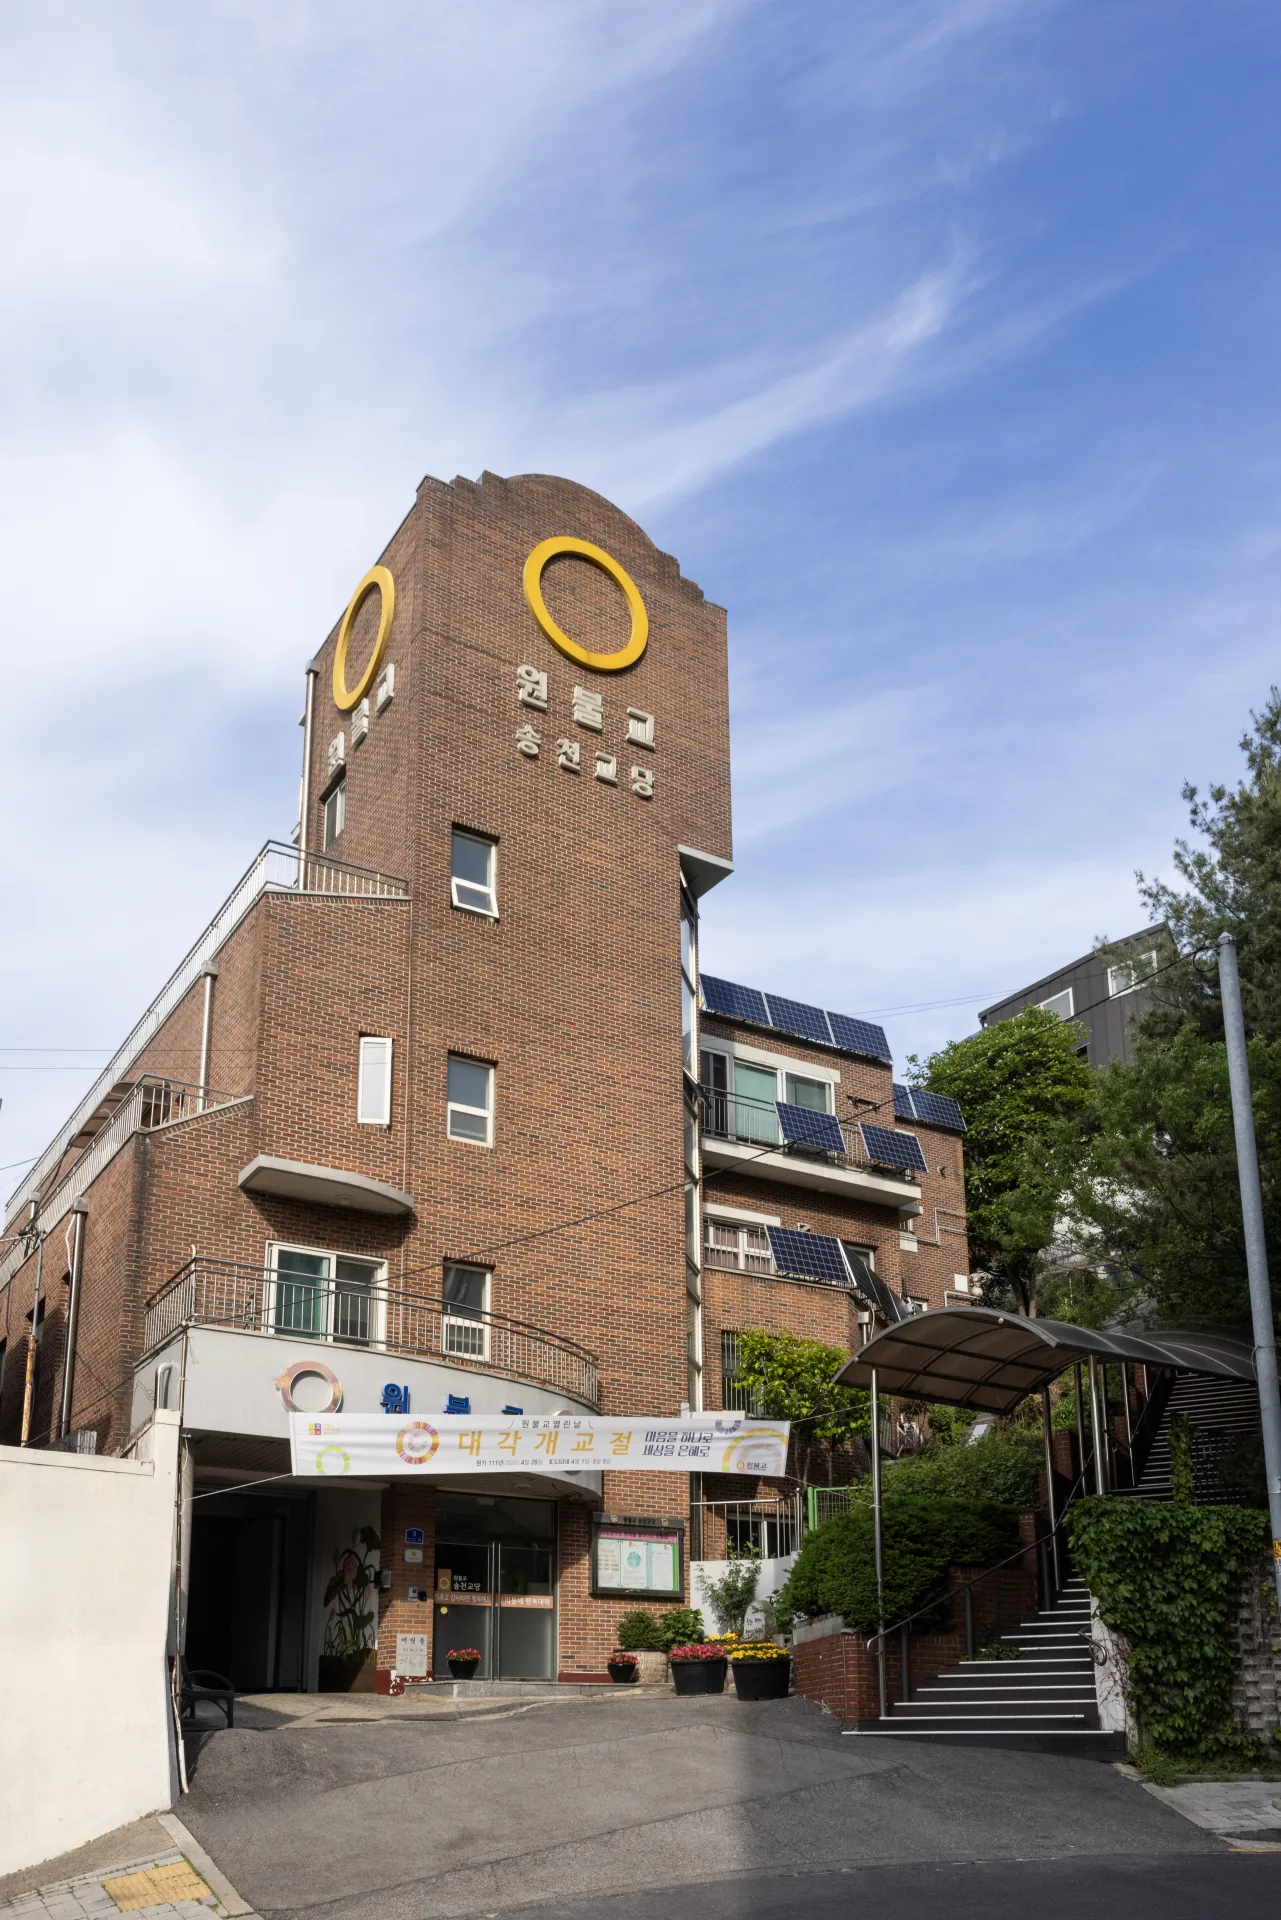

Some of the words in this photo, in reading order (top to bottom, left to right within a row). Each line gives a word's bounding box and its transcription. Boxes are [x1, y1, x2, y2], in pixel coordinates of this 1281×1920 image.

[516, 664, 656, 750] 원불교
[515, 724, 655, 799] 송천교당
[458, 1430, 633, 1457] 대각개교절
[644, 1431, 678, 1443] 마음을
[680, 1432, 713, 1444] 하나로
[641, 1444, 675, 1457] 세상을
[677, 1445, 711, 1458] 은혜로
[453, 1582, 481, 1592] 송천교당
